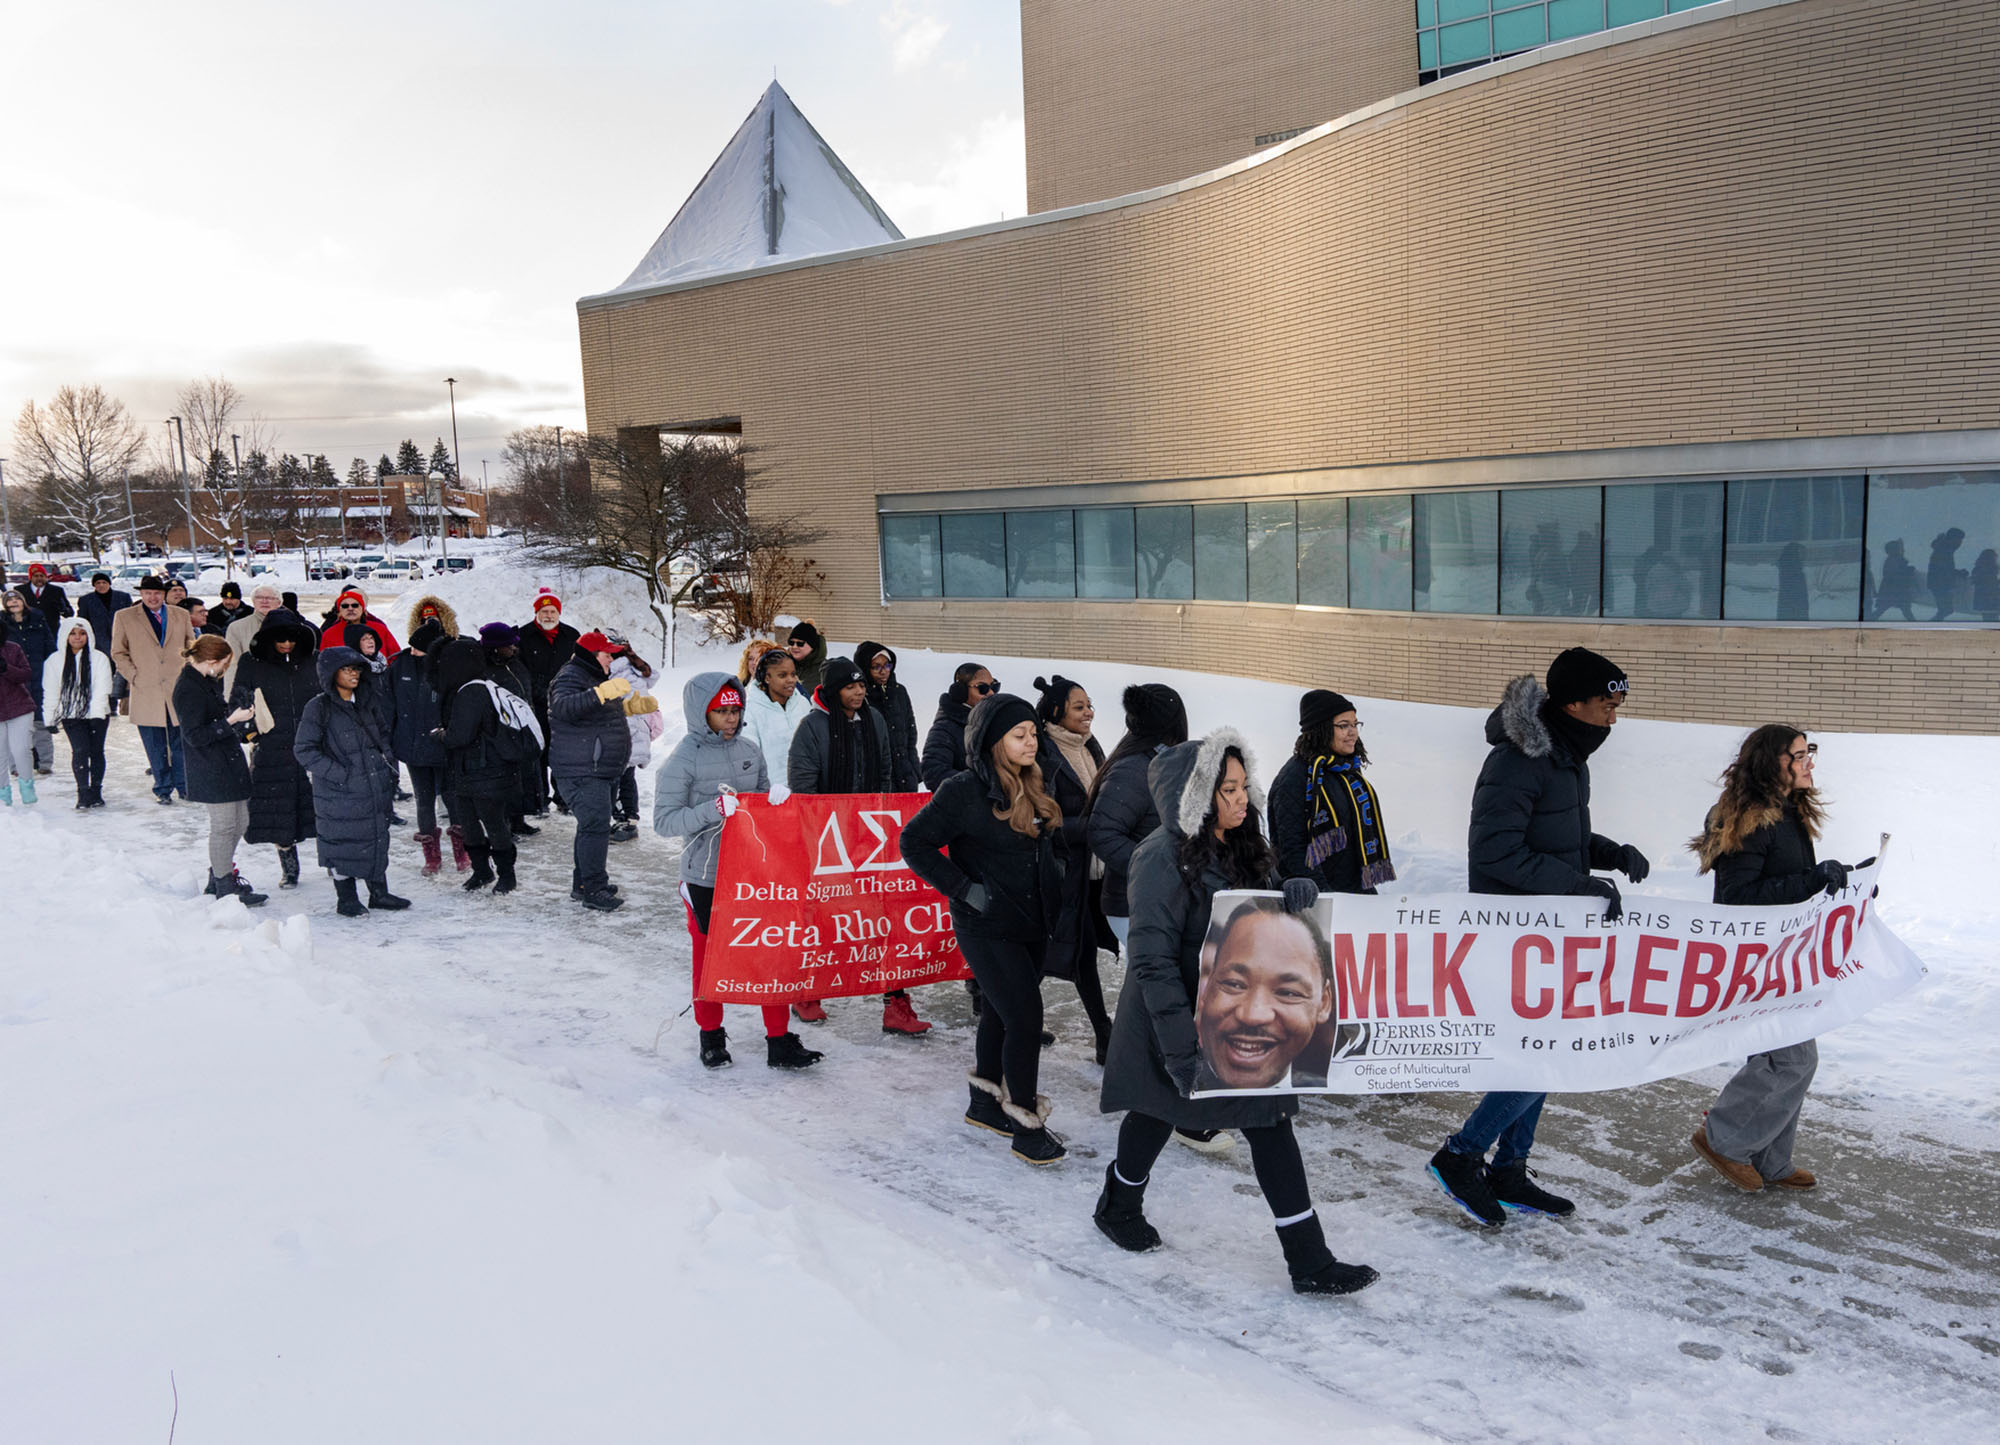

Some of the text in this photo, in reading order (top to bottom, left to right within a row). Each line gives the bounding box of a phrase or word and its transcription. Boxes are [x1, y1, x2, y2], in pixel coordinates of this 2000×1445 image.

[734, 882, 799, 901] Delta
[806, 882, 853, 902] Sigma
[855, 875, 917, 894] Theta
[728, 917, 821, 948] Zeta
[831, 910, 892, 944] Rho
[1396, 909, 1442, 925] THE
[1458, 910, 1566, 929] ANNUAL
[1690, 919, 1767, 937] STATE
[799, 951, 839, 970] Est.
[846, 944, 888, 966] May
[895, 942, 932, 960] 24,
[715, 976, 815, 994] Sisterhood
[859, 960, 947, 984] Scholarship
[1334, 932, 1479, 1020] MLK
[1374, 1020, 1496, 1039] FERRIS STATE
[1521, 1036, 1557, 1051] for
[1572, 1031, 1635, 1052] details
[1372, 1039, 1482, 1056] UNIVERSITY
[1354, 1063, 1471, 1077] Office of Multicultural
[1367, 1077, 1460, 1090] Student Services
